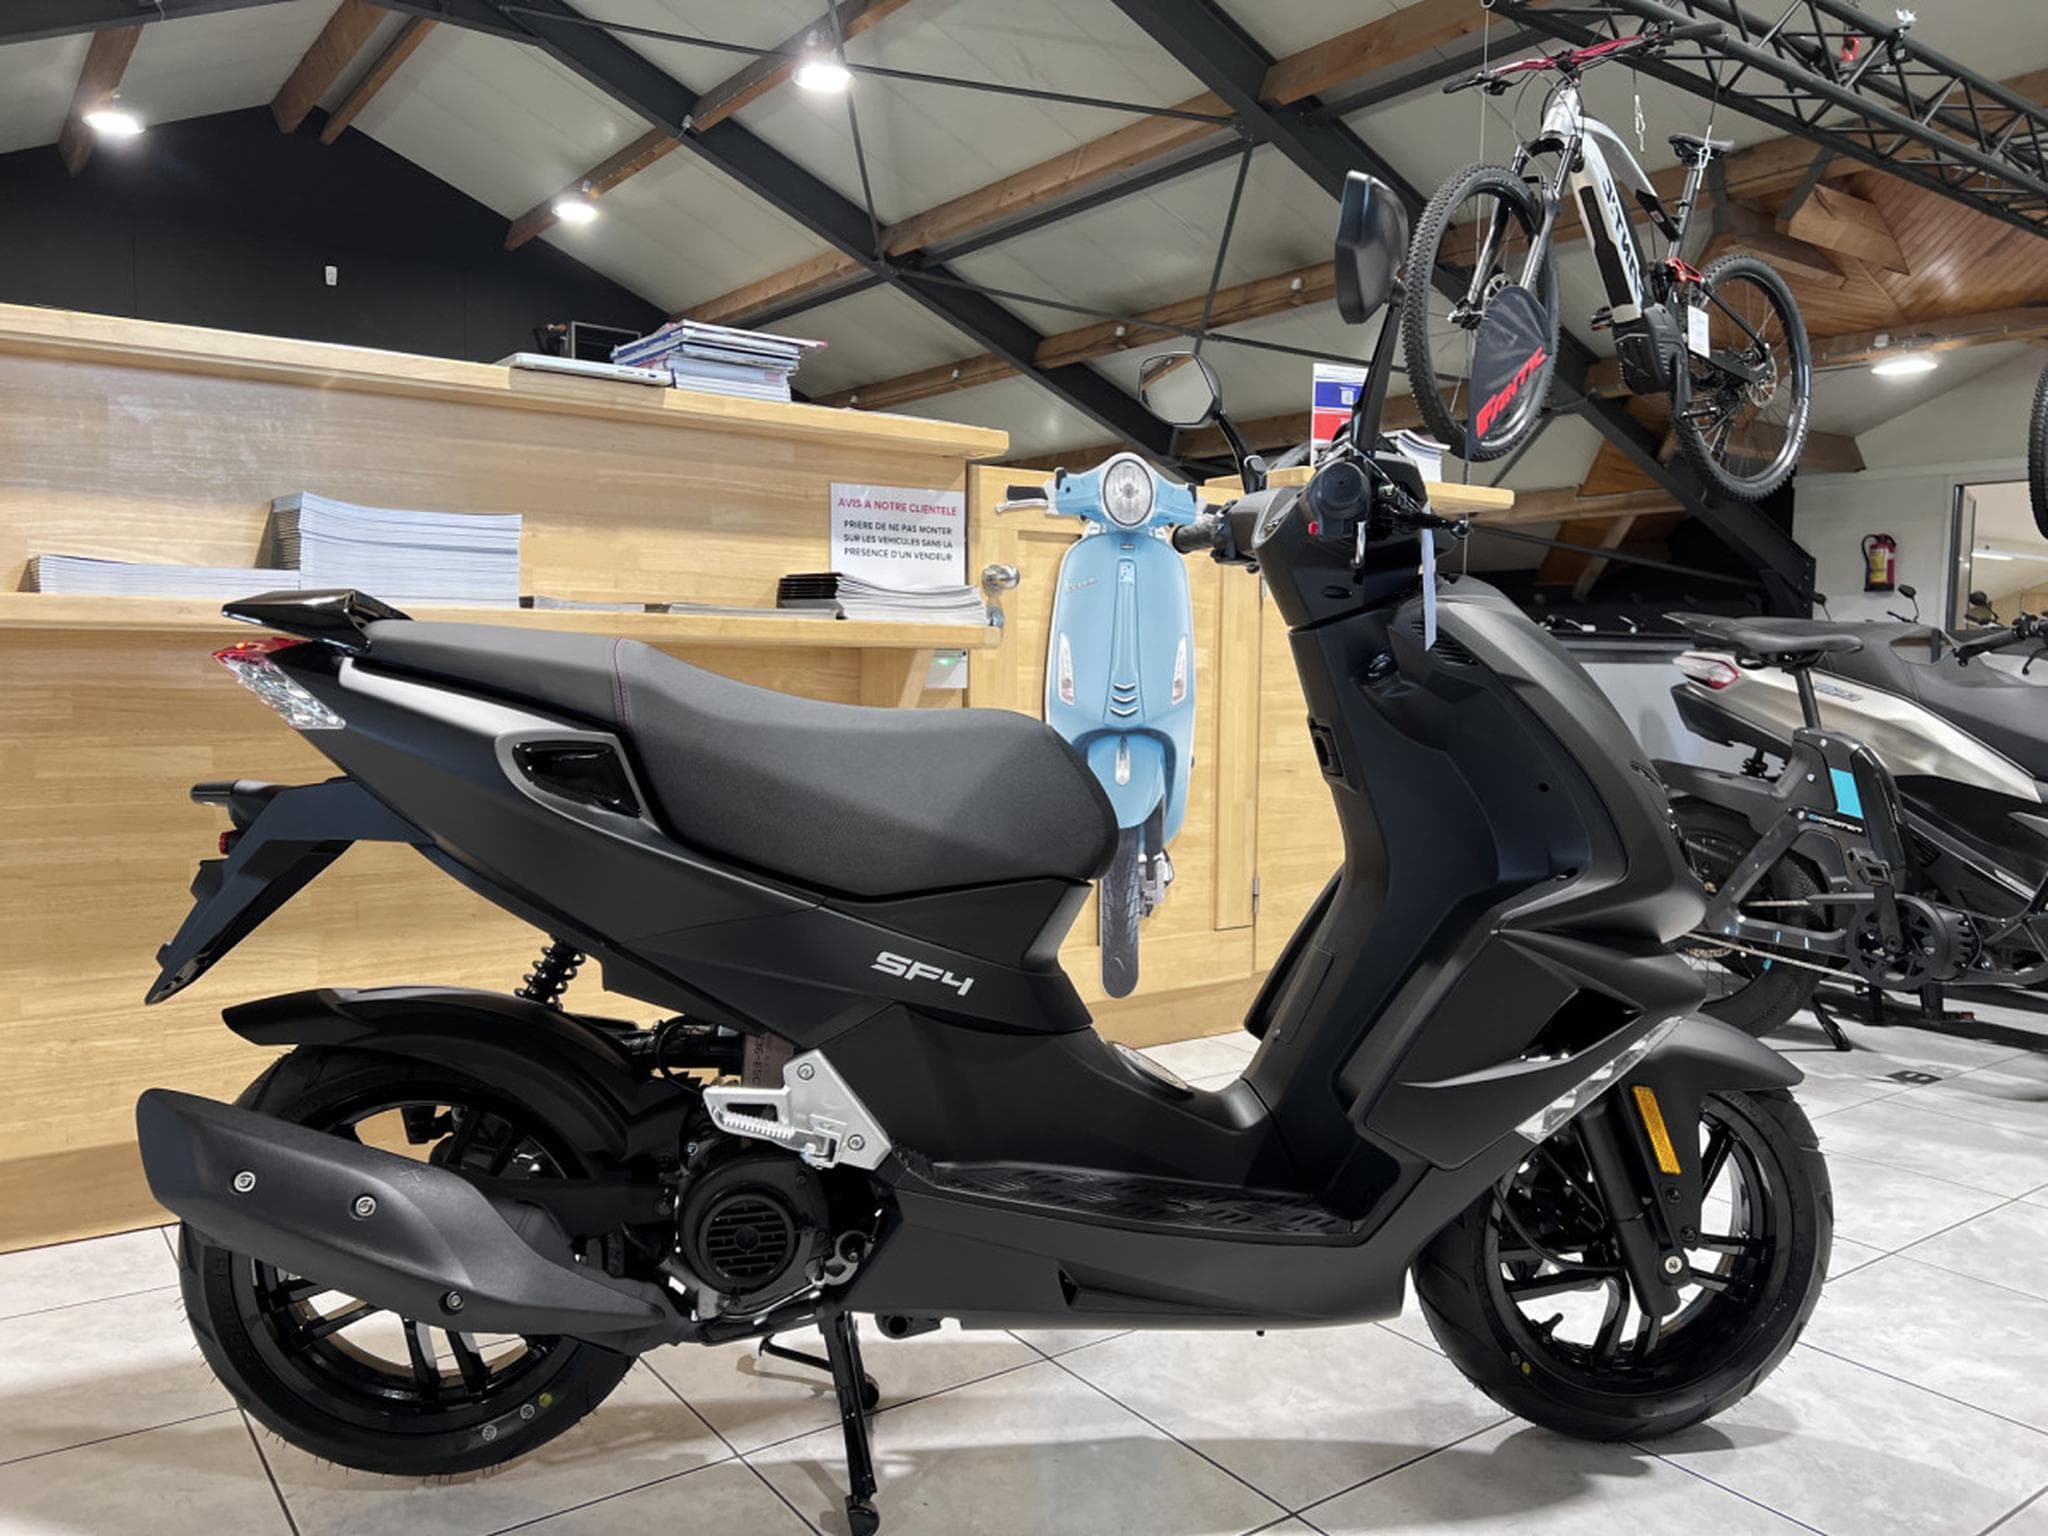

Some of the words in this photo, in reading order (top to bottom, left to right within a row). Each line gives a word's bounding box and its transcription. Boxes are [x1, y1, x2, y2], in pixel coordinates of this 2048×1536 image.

[838, 497, 862, 508] AVIS
[864, 500, 872, 509] A
[874, 501, 907, 512] NOTRE
[909, 503, 957, 516] CLIENTELE
[844, 520, 873, 530] PRIERE
[875, 522, 886, 531] DE
[888, 523, 899, 532] NE
[901, 524, 917, 533] PAS
[919, 526, 953, 535] MONTER
[843, 533, 860, 542] SUR
[862, 535, 876, 543] LES
[877, 536, 920, 546] VEHICULES
[921, 538, 941, 548] SANS
[943, 540, 953, 548] LA
[844, 547, 889, 558] PRESENCE
[890, 549, 912, 559] D'UN
[914, 551, 953, 561] VENDEUR
[870, 951, 974, 997] SF4
